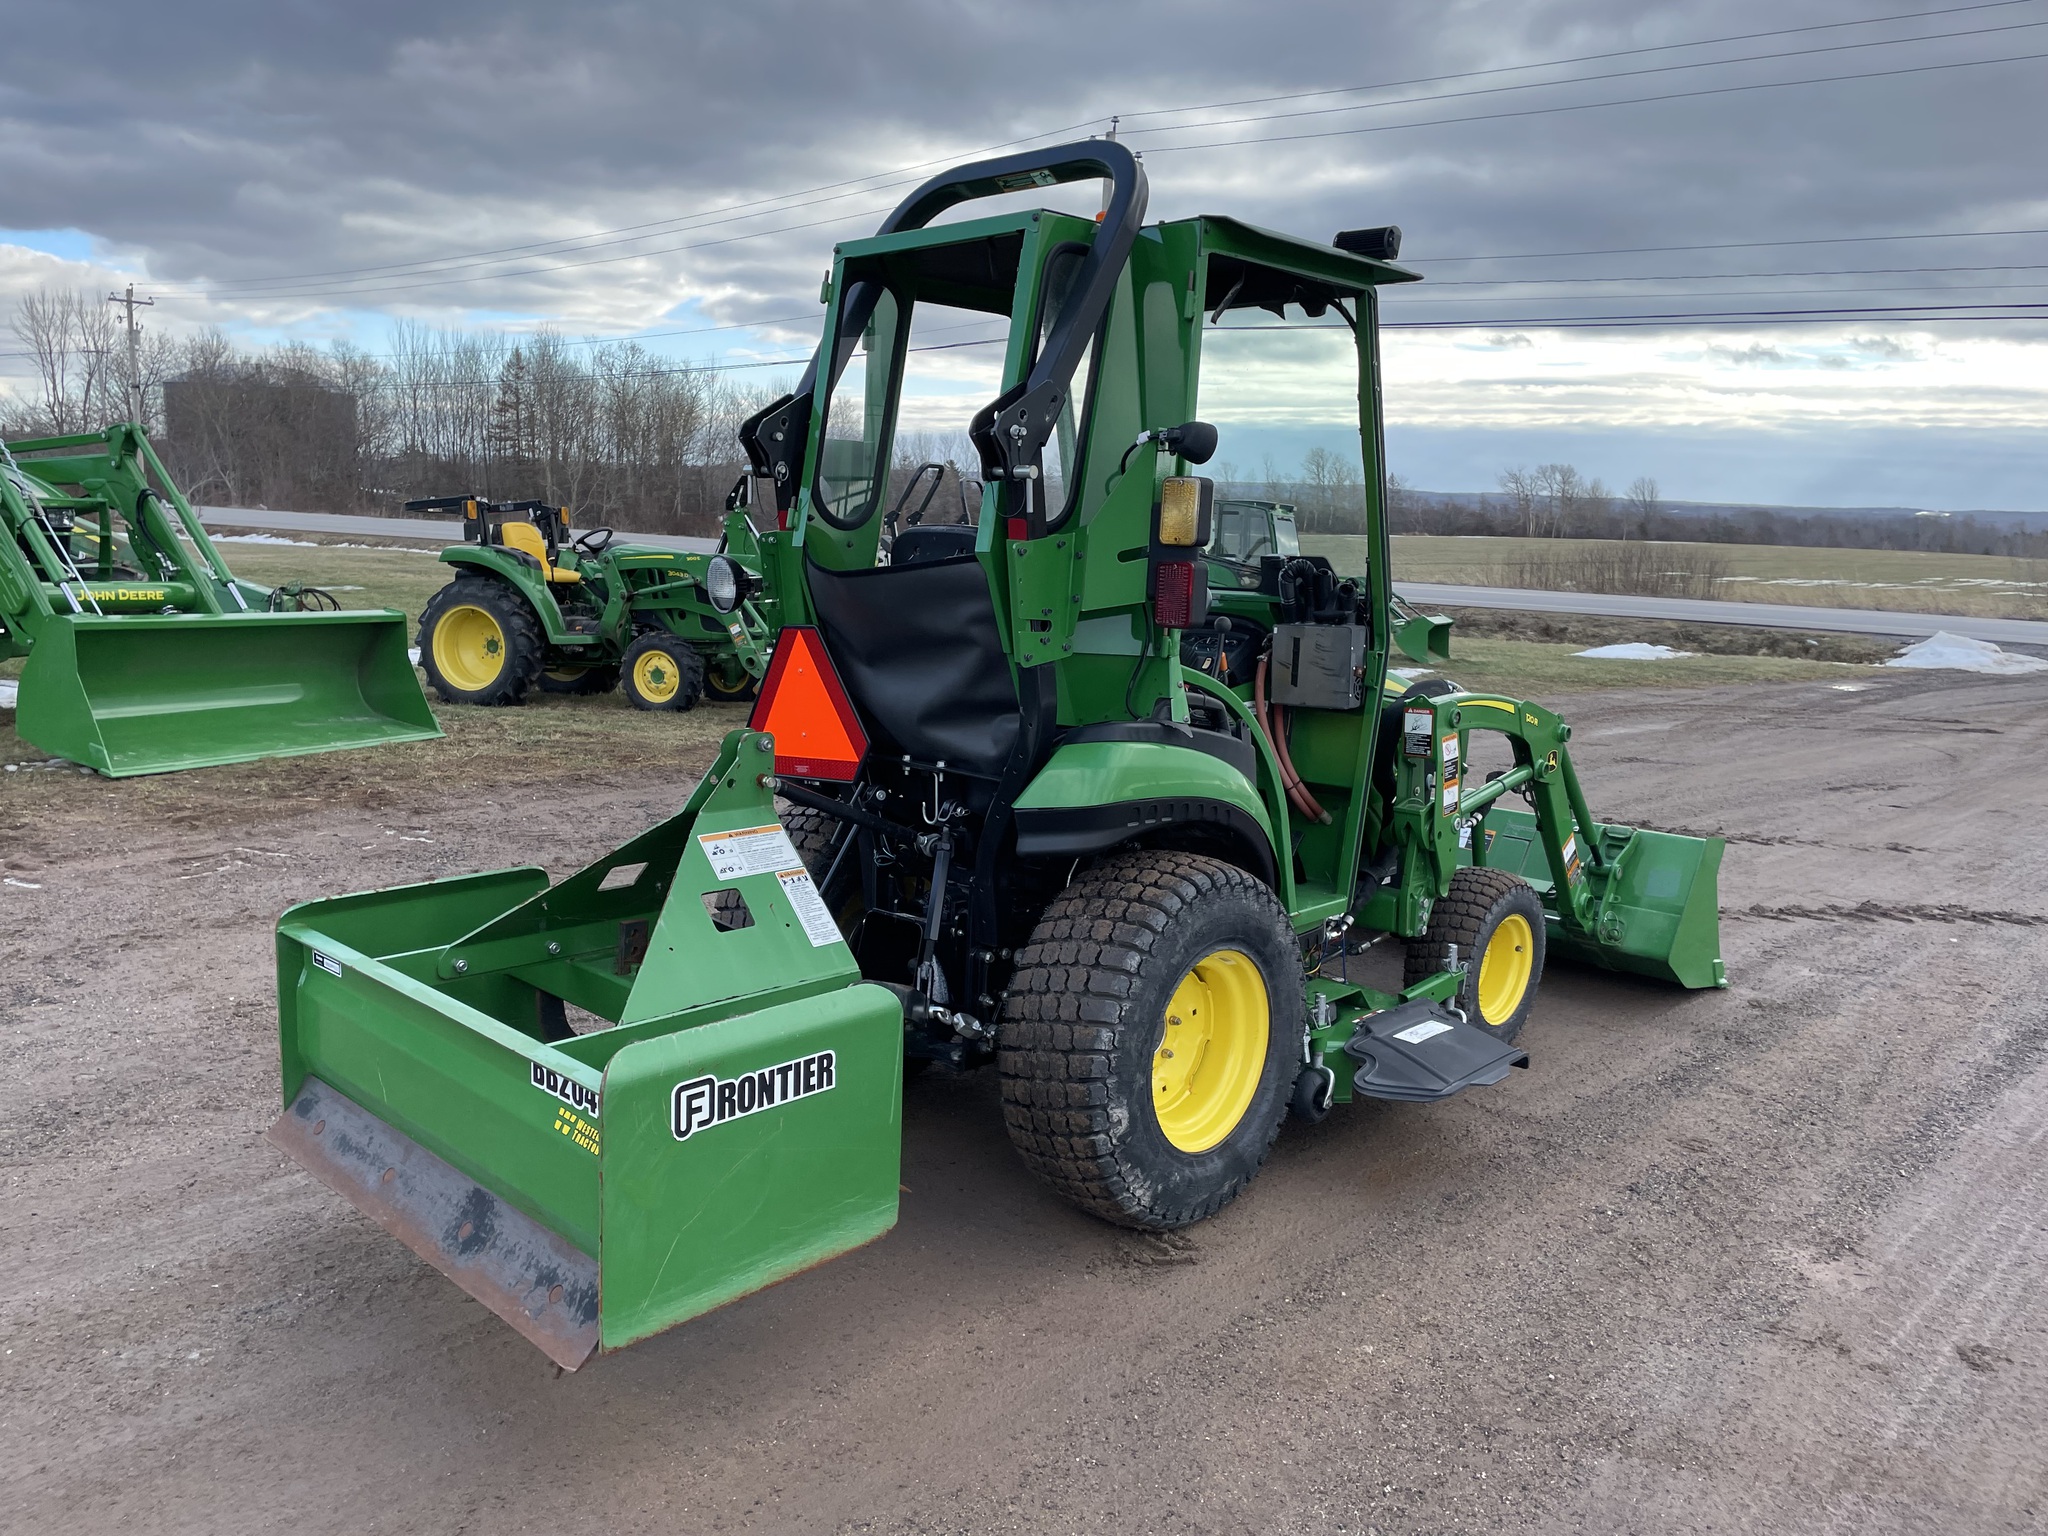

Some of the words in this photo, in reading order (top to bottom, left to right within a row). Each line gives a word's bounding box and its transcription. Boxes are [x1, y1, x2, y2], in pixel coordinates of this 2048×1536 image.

[77, 589, 115, 600] JOHN
[118, 589, 165, 600] DEERE
[674, 1052, 834, 1139] FRONTIER
